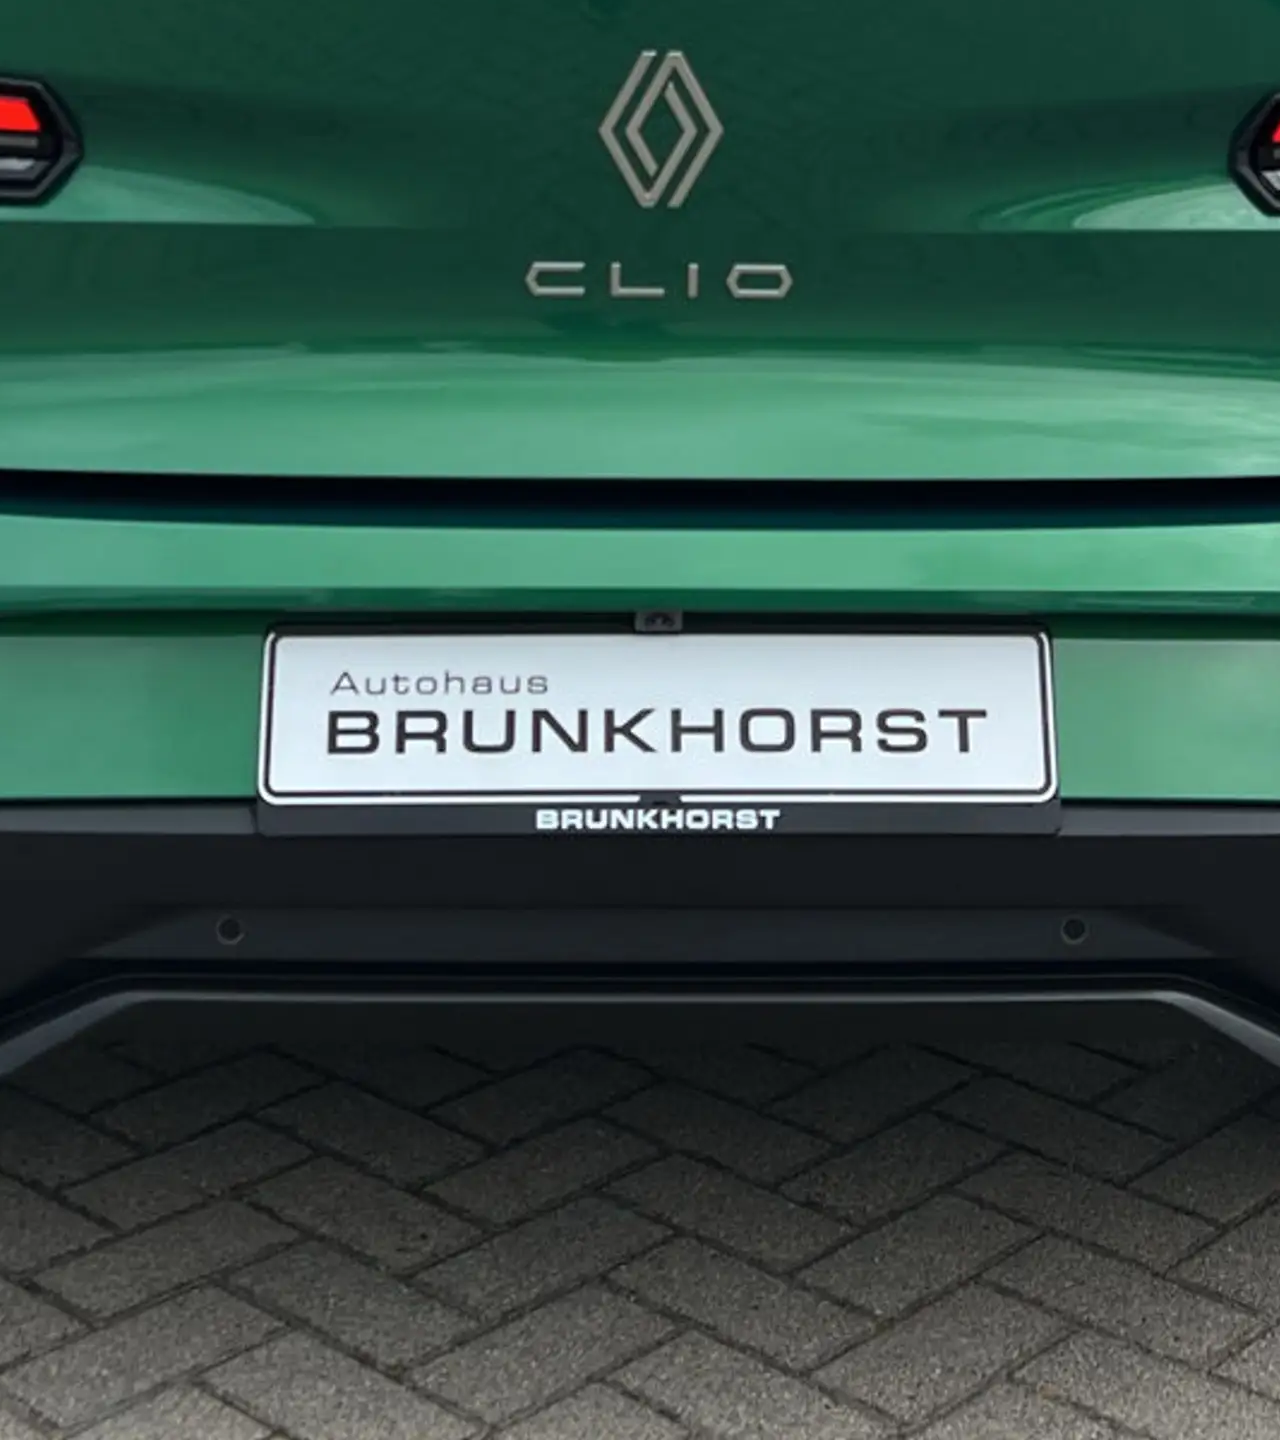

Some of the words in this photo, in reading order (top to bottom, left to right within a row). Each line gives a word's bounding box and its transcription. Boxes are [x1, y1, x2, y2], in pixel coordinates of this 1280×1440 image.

[525, 261, 793, 298] CLIO
[330, 670, 548, 695] Autohaus
[328, 708, 987, 754] BRUNKHORST
[536, 809, 781, 830] BRUNKHORST
